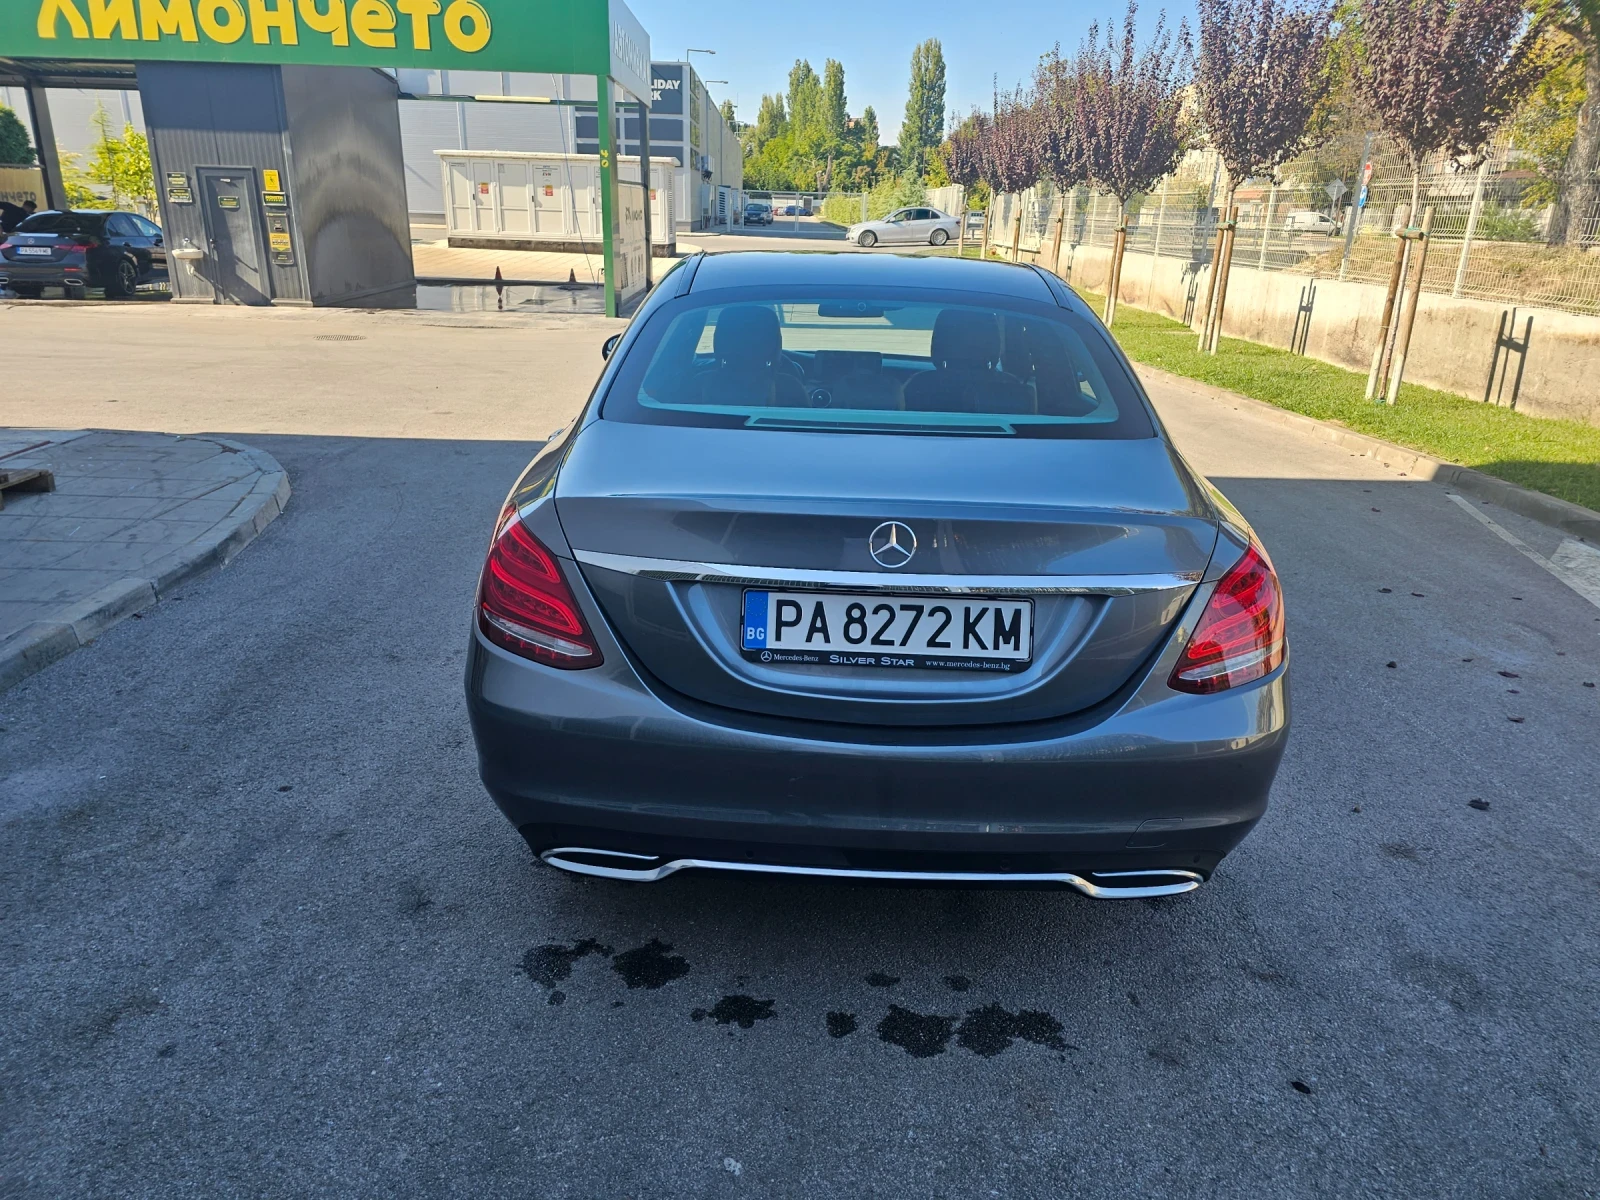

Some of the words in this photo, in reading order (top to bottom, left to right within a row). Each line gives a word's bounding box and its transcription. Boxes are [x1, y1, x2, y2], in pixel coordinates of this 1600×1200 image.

[746, 626, 765, 640] BG
[775, 599, 831, 644] PA
[843, 602, 953, 648] 8272
[963, 606, 1022, 652] KM
[773, 653, 819, 662] Mercedes-Benz
[925, 660, 1011, 671] www.mercedes-benz.bg
